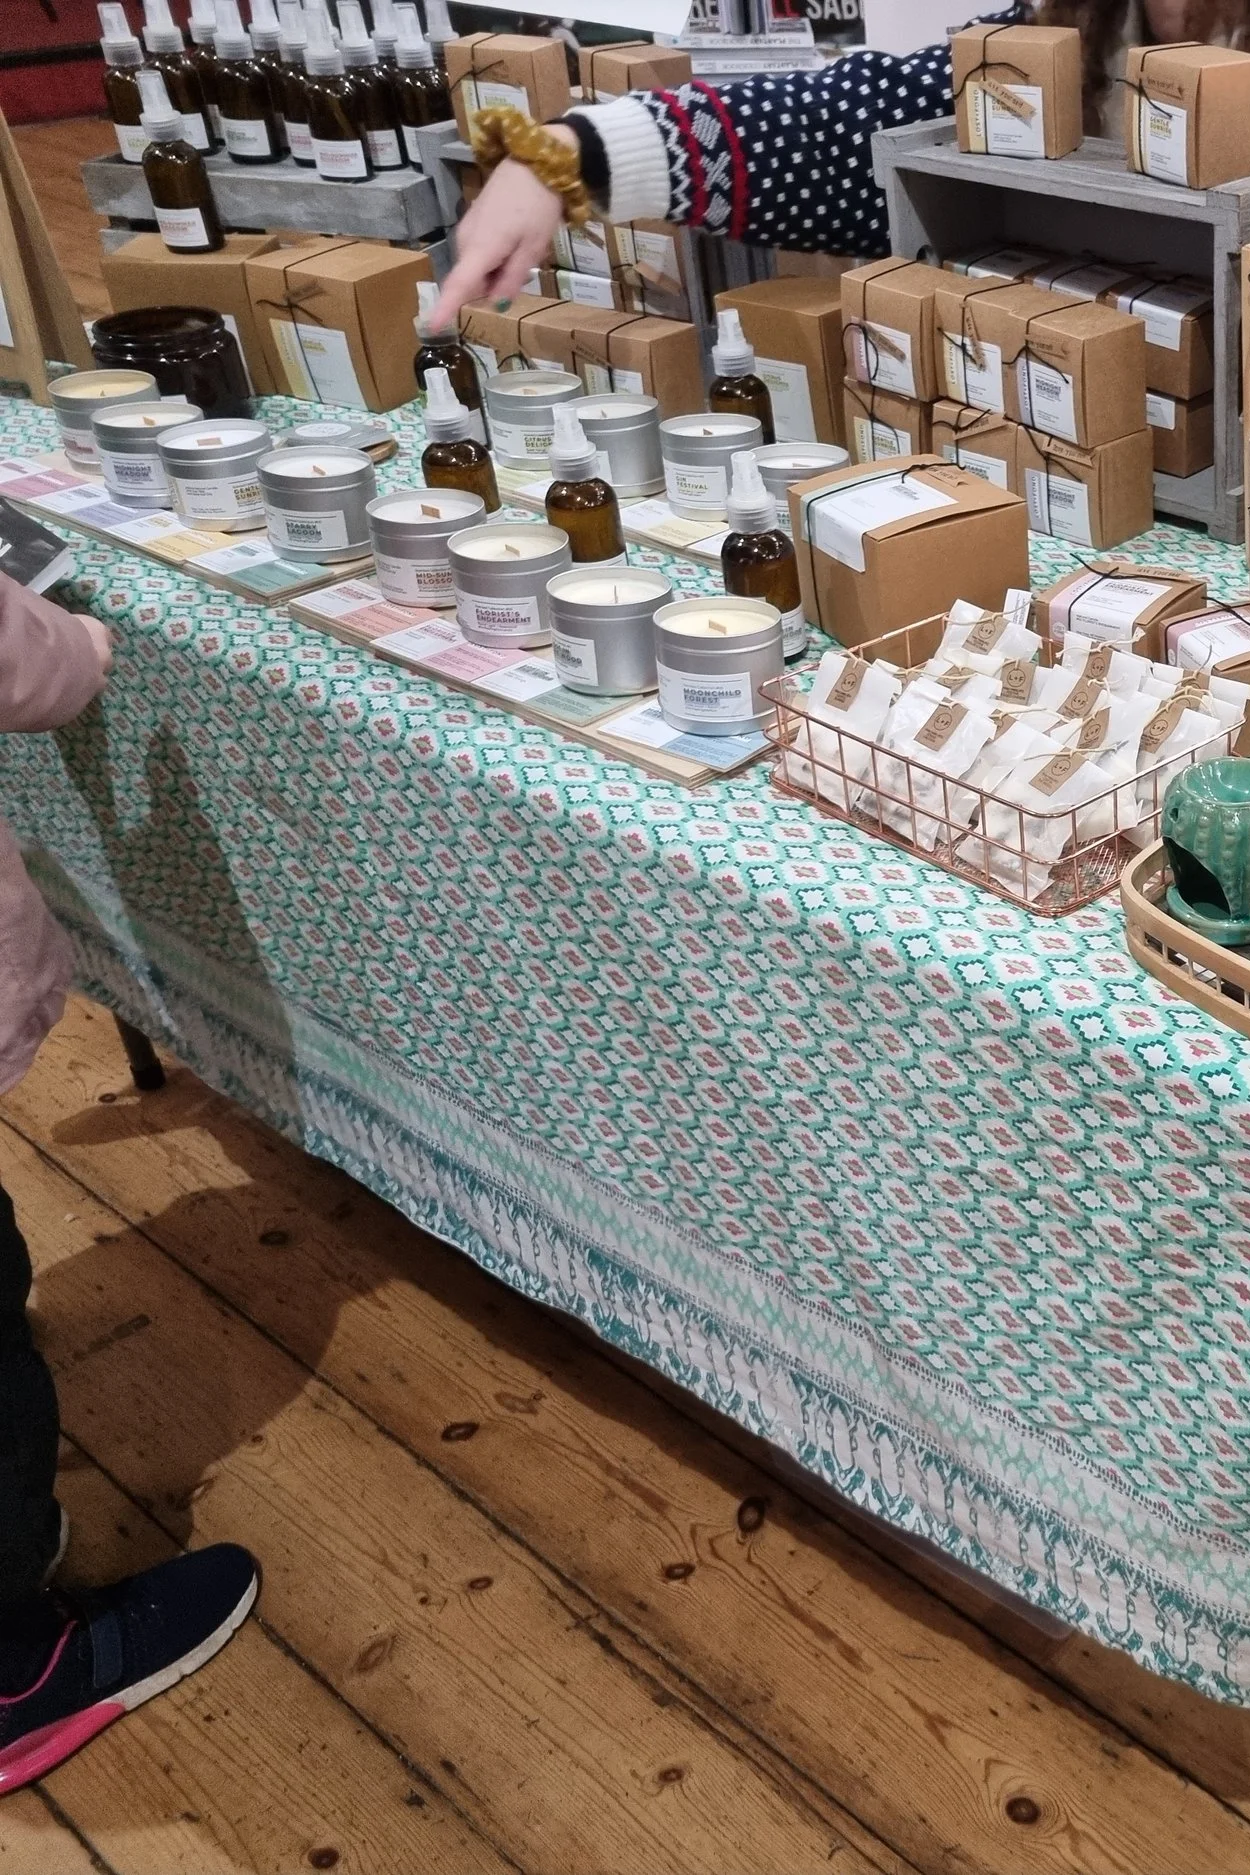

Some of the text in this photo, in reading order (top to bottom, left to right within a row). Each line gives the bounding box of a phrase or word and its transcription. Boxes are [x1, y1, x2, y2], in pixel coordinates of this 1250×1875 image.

[233, 484, 261, 495] GENTL
[676, 481, 709, 490] FESTIVAL
[235, 490, 262, 501] SUNRI
[417, 577, 454, 585] BLOSSO
[475, 608, 521, 618] FLORIST'S
[476, 614, 532, 624] ENDEARMENT
[683, 687, 742, 698] MOONCHILD
[684, 694, 719, 705] FOREST
